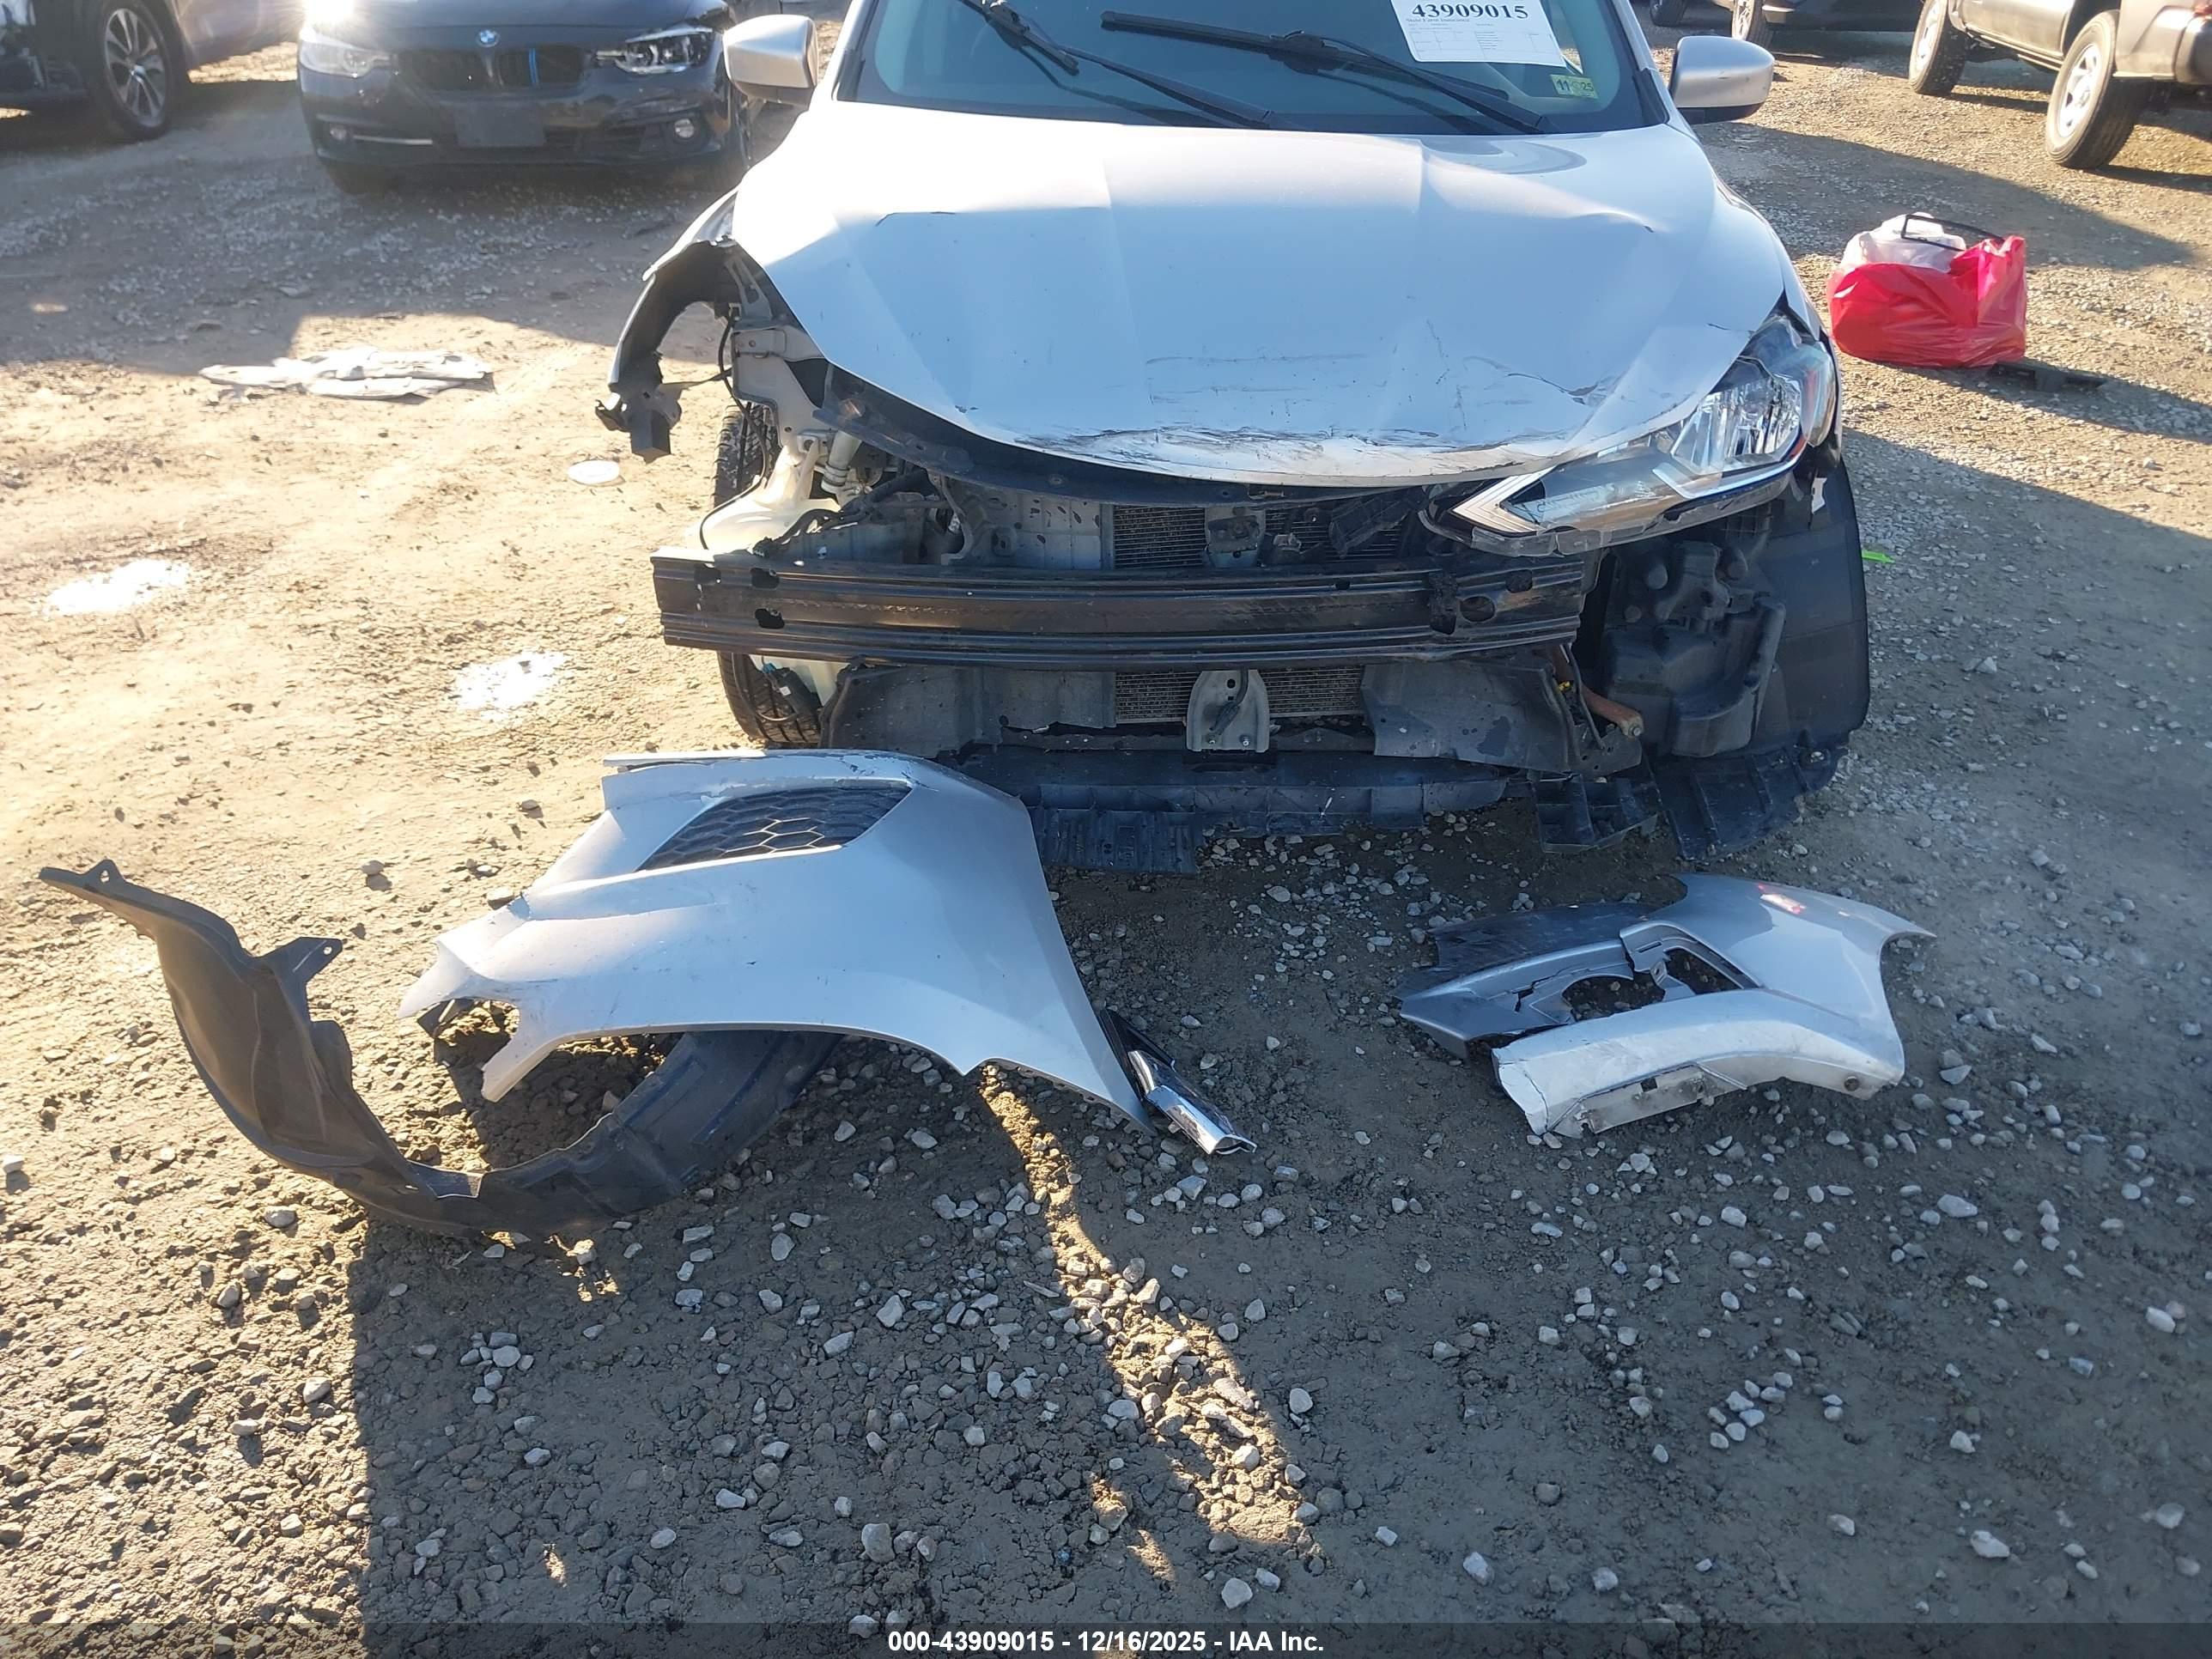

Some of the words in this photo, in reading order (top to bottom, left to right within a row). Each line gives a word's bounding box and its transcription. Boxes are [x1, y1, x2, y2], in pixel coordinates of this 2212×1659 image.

[1412, 3, 1529, 19] 43909015
[1556, 79, 1571, 91] 11
[1581, 82, 1595, 92] 25
